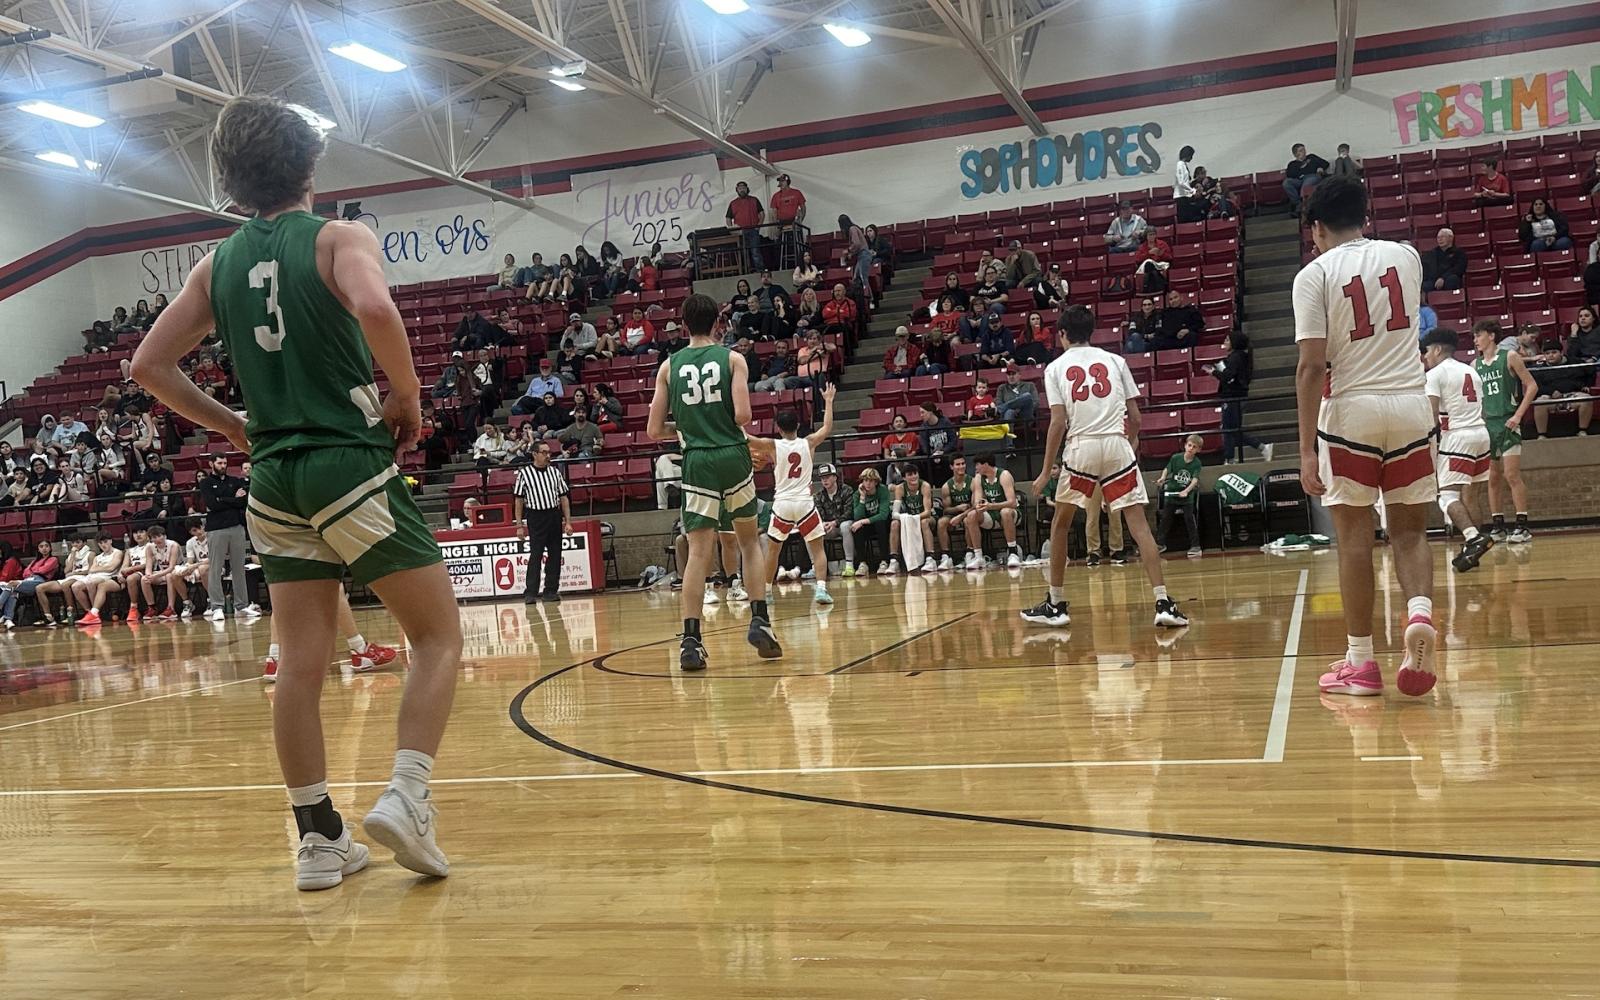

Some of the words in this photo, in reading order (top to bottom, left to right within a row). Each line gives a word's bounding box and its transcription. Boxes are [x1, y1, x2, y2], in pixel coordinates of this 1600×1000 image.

[1393, 65, 1600, 145] FRESHMEN
[960, 122, 1163, 198] SOPHOMORES
[577, 172, 714, 245] Juniors
[632, 217, 682, 247] 2025
[248, 259, 286, 352] 3
[1342, 266, 1410, 342] 11
[679, 361, 722, 405] 32
[1066, 363, 1111, 402] 23
[1462, 373, 1478, 402] 4
[1481, 370, 1502, 382] WALL
[1487, 381, 1500, 395] 13
[787, 452, 802, 479] 2
[483, 542, 518, 555] HIGH
